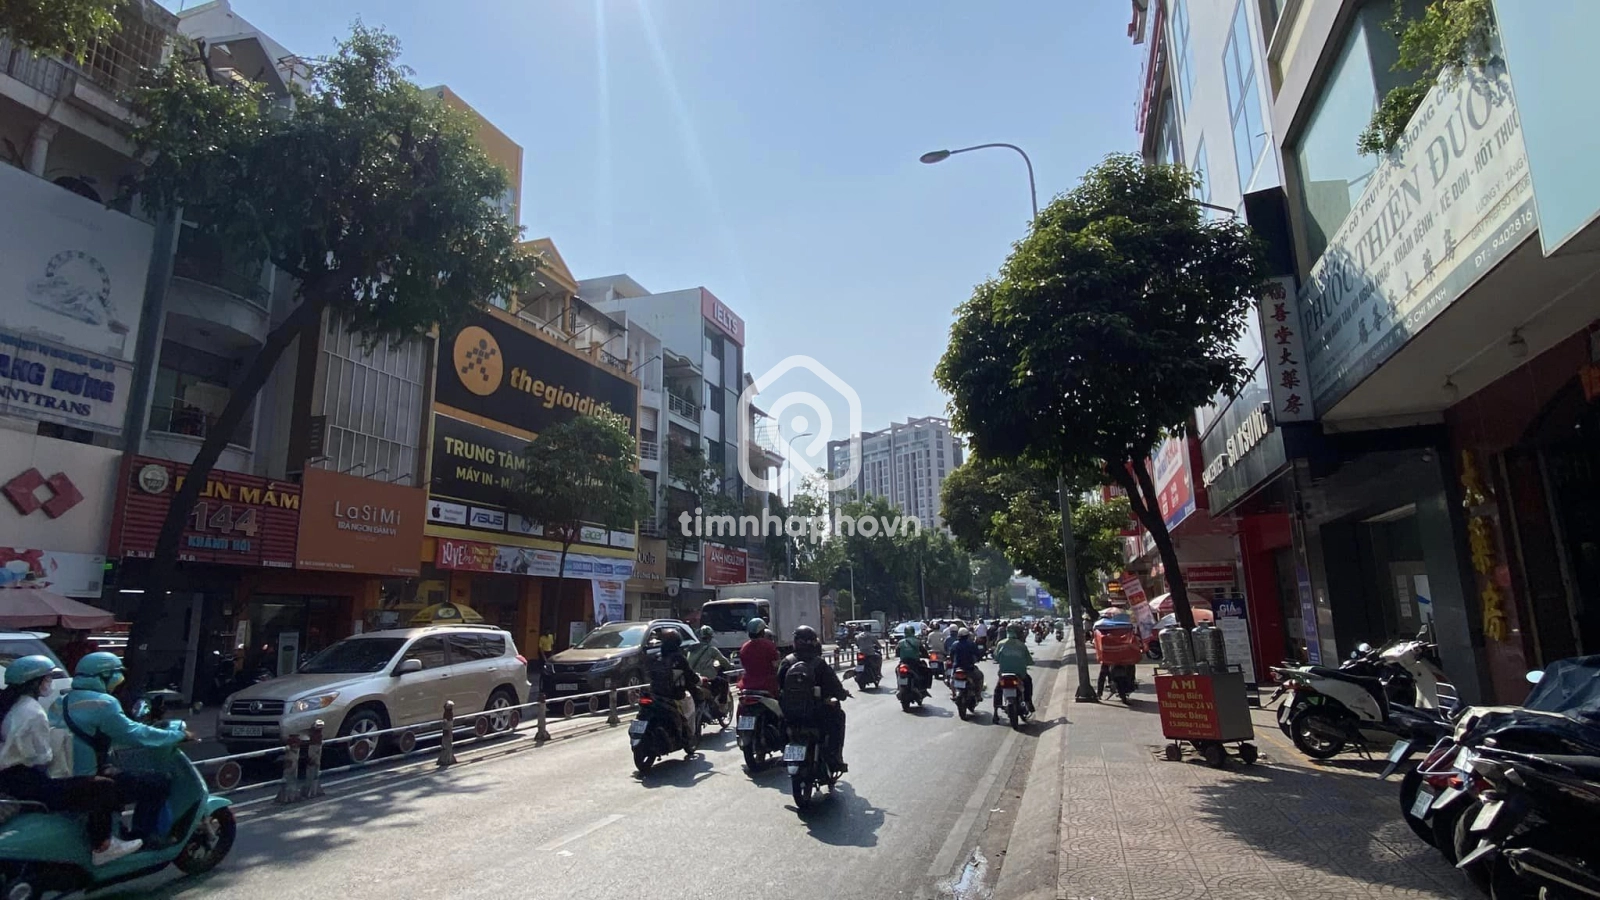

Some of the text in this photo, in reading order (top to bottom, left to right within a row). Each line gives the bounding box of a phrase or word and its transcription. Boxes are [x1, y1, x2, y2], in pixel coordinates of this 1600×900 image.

[1355, 163, 1422, 272] THIỆN
[1412, 210, 1434, 245] BỆNH
[1491, 209, 1533, 250] 9402816
[713, 302, 738, 335] IELTS
[444, 436, 525, 471] TRUNG TÂM
[456, 466, 480, 482] MÁY
[482, 470, 493, 485] IN
[190, 501, 258, 537] 144
[335, 501, 400, 525] LaSiMi
[472, 512, 503, 526] ASUS
[1171, 680, 1179, 690] A
